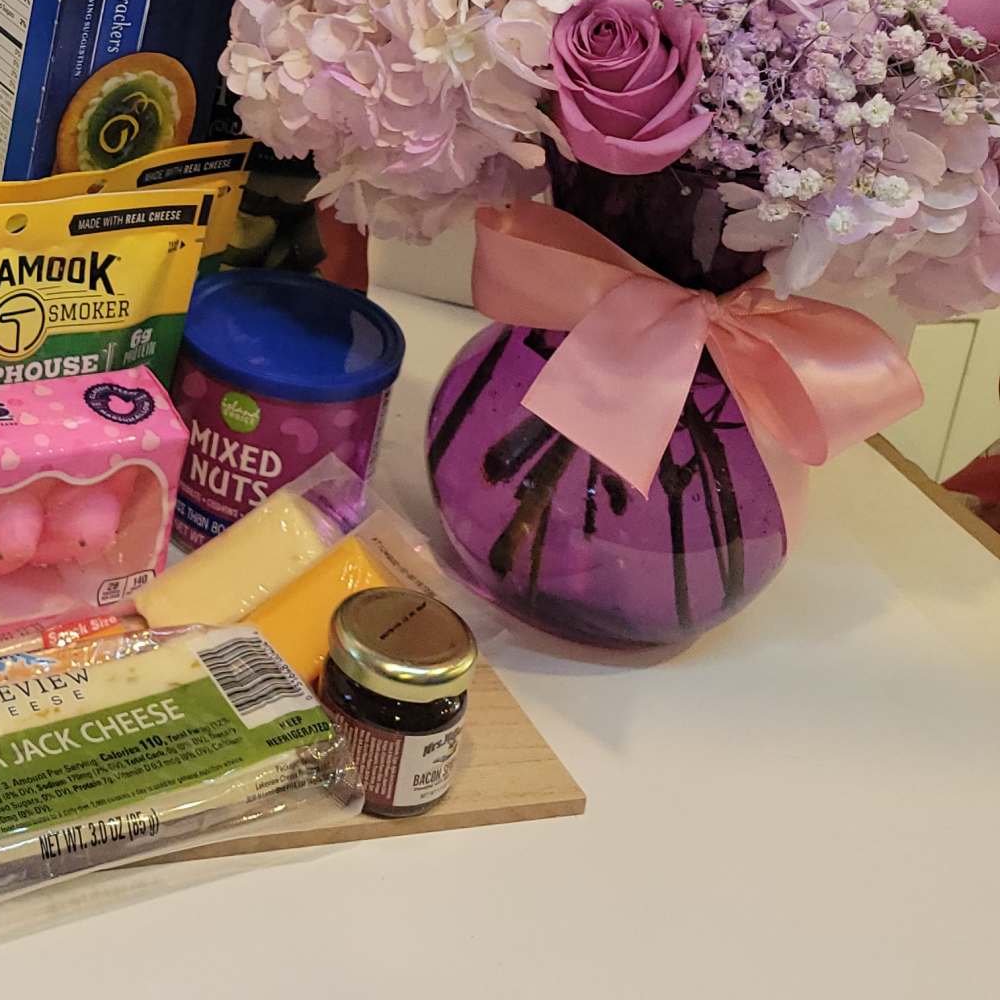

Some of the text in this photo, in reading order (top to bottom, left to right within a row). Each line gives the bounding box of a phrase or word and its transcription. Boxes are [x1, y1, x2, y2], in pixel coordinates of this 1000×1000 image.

[184, 159, 233, 174] REAL CHEESE
[78, 210, 182, 230] MADE WITH REAL CHEESE
[48, 300, 130, 323] SMOKER
[190, 419, 282, 478] MIXED
[190, 453, 269, 507] NUTS
[90, 615, 118, 631] Size
[11, 731, 81, 766] JACK
[80, 698, 186, 746] CHEESE
[266, 720, 330, 748] REFRIGERATED
[280, 715, 303, 729] KEEP
[10, 770, 48, 788] Amount
[97, 743, 141, 762] Calories
[413, 769, 441, 787] BACON
[39, 831, 61, 860] NET
[63, 825, 88, 853] WT.
[89, 818, 107, 848] 3.0
[108, 816, 126, 841] OZ
[127, 810, 146, 841] (85
